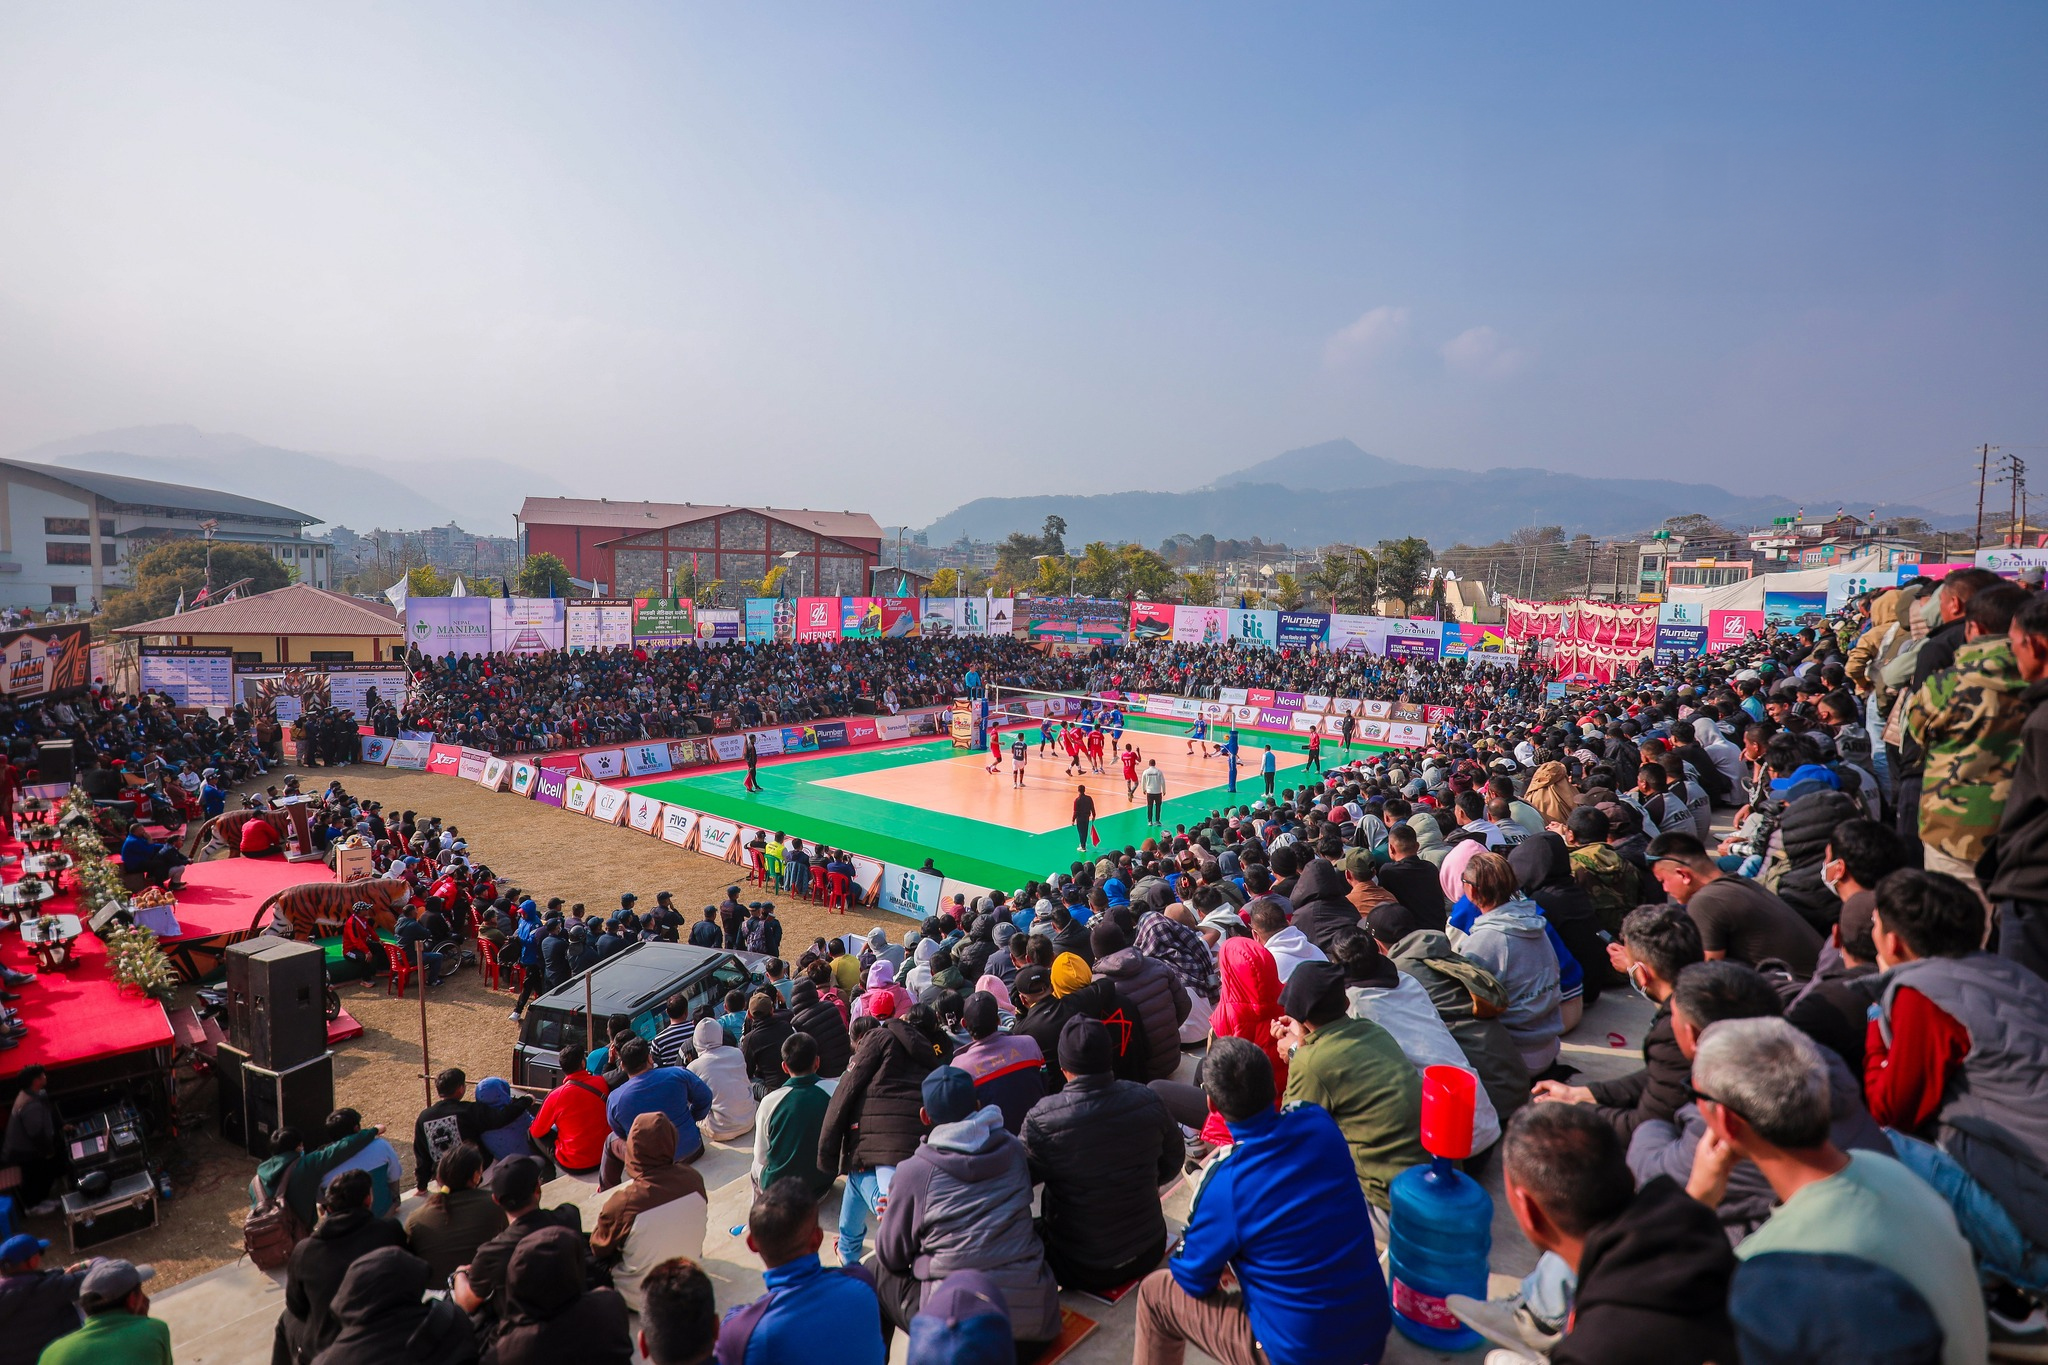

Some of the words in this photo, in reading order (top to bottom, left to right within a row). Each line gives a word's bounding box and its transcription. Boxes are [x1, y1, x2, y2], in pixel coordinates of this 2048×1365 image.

[1281, 615, 1323, 625] Plumber
[437, 625, 487, 634] MANIPAL
[800, 630, 836, 640] INTERNET
[1405, 626, 1435, 635] Franklin
[1659, 628, 1702, 638] Plumber
[10, 657, 44, 678] TIGER
[10, 678, 26, 688] CUP
[26, 674, 43, 684] 2025
[1276, 696, 1302, 707] Ncell
[1261, 712, 1288, 725] Ncell
[817, 729, 843, 738] Plumber
[852, 727, 874, 739] XTEP
[431, 752, 458, 765] XTEP
[537, 777, 563, 799] Ncell
[573, 799, 584, 807] CLIFF
[669, 814, 687, 828] FIVB
[708, 829, 730, 843] AVC
